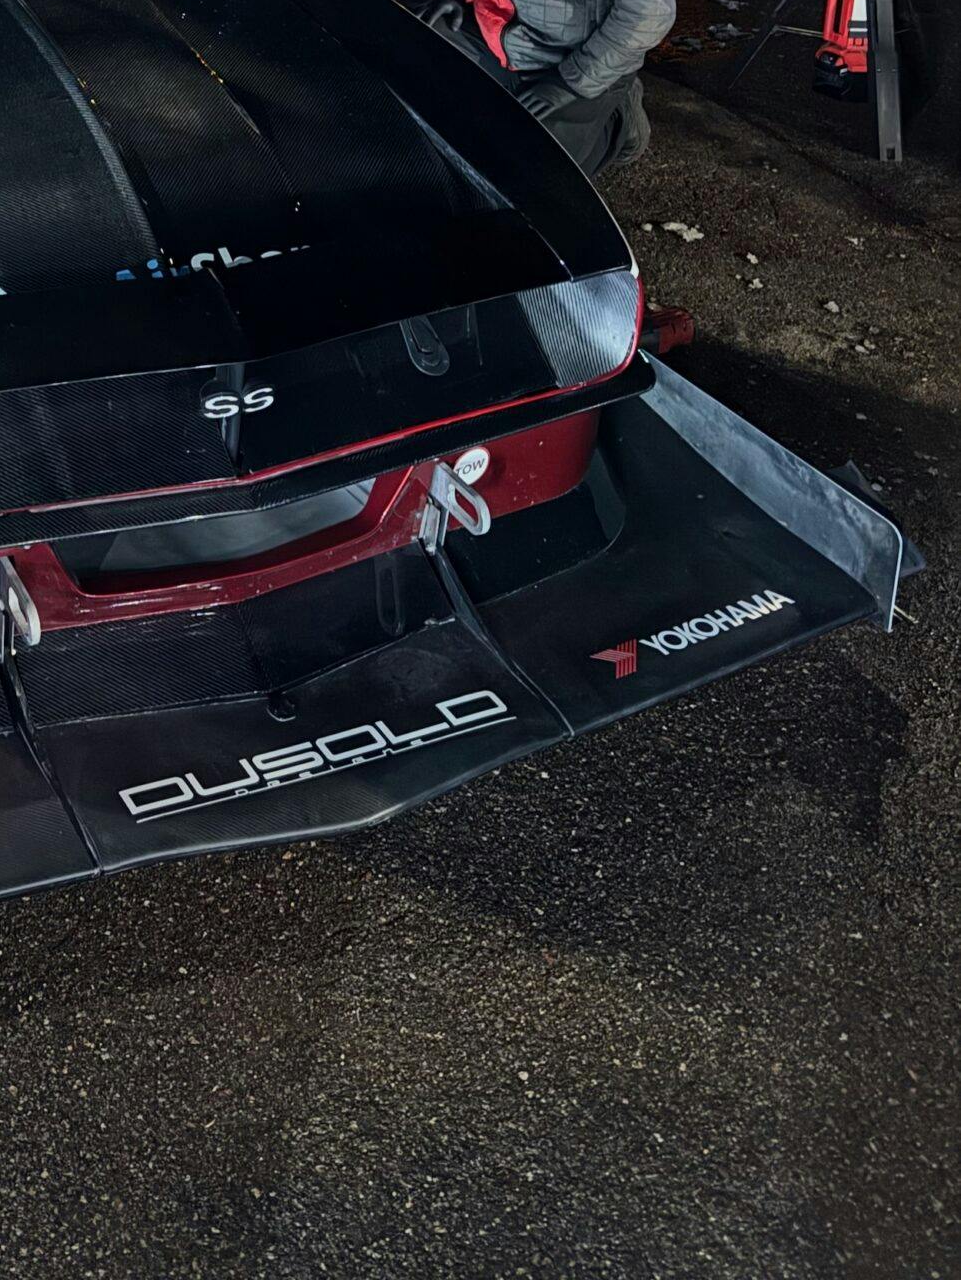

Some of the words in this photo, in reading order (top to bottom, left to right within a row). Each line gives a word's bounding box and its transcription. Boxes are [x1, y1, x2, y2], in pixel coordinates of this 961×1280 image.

[204, 386, 275, 419] SS
[639, 589, 796, 656] YOKOHAMA
[118, 690, 509, 815] DUSOLD
